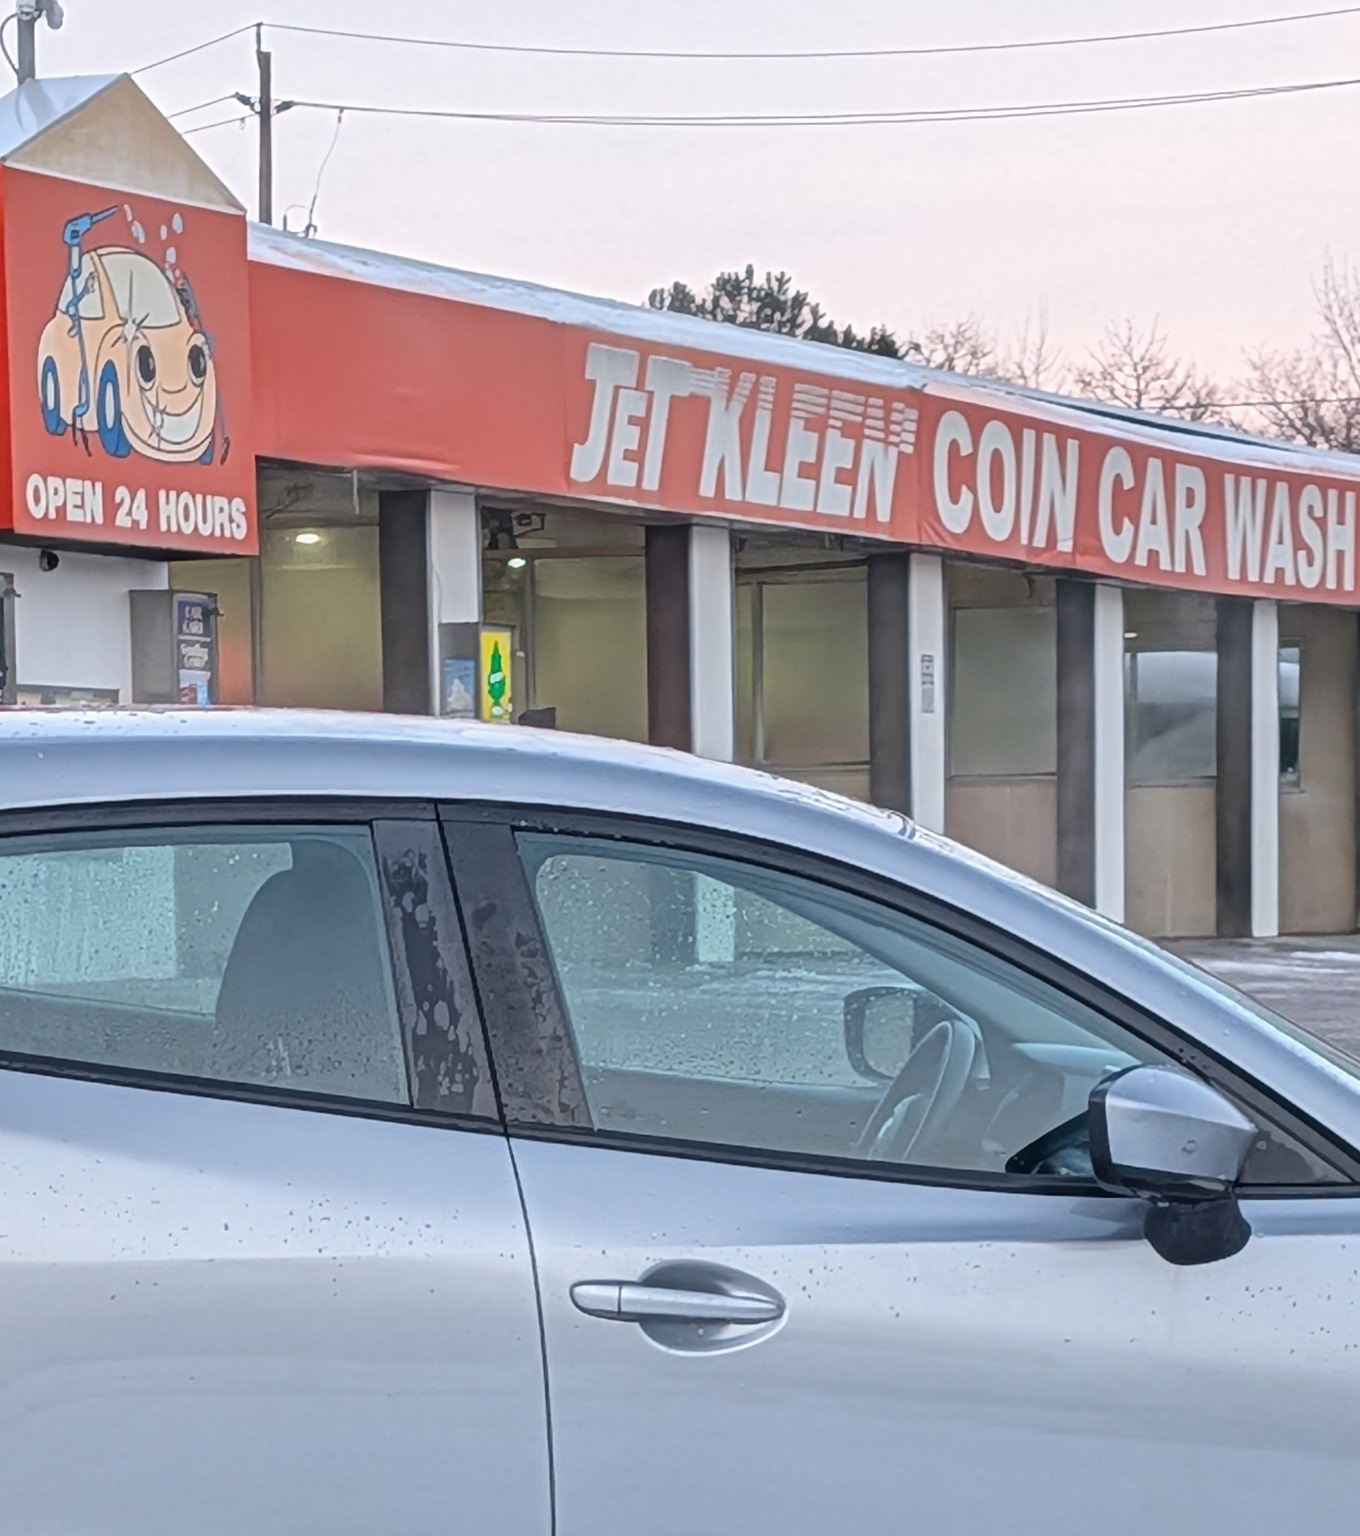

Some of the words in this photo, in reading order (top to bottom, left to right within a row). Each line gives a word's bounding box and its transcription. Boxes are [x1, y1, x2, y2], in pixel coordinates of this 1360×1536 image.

[26, 473, 104, 524] OPEN
[114, 485, 149, 529] 24
[158, 489, 248, 540] HOURS
[570, 342, 692, 491] JET
[698, 366, 920, 523] KLEEN
[933, 410, 1080, 552] COIN
[1098, 445, 1207, 576] CAR
[1224, 473, 1357, 591] WASH
